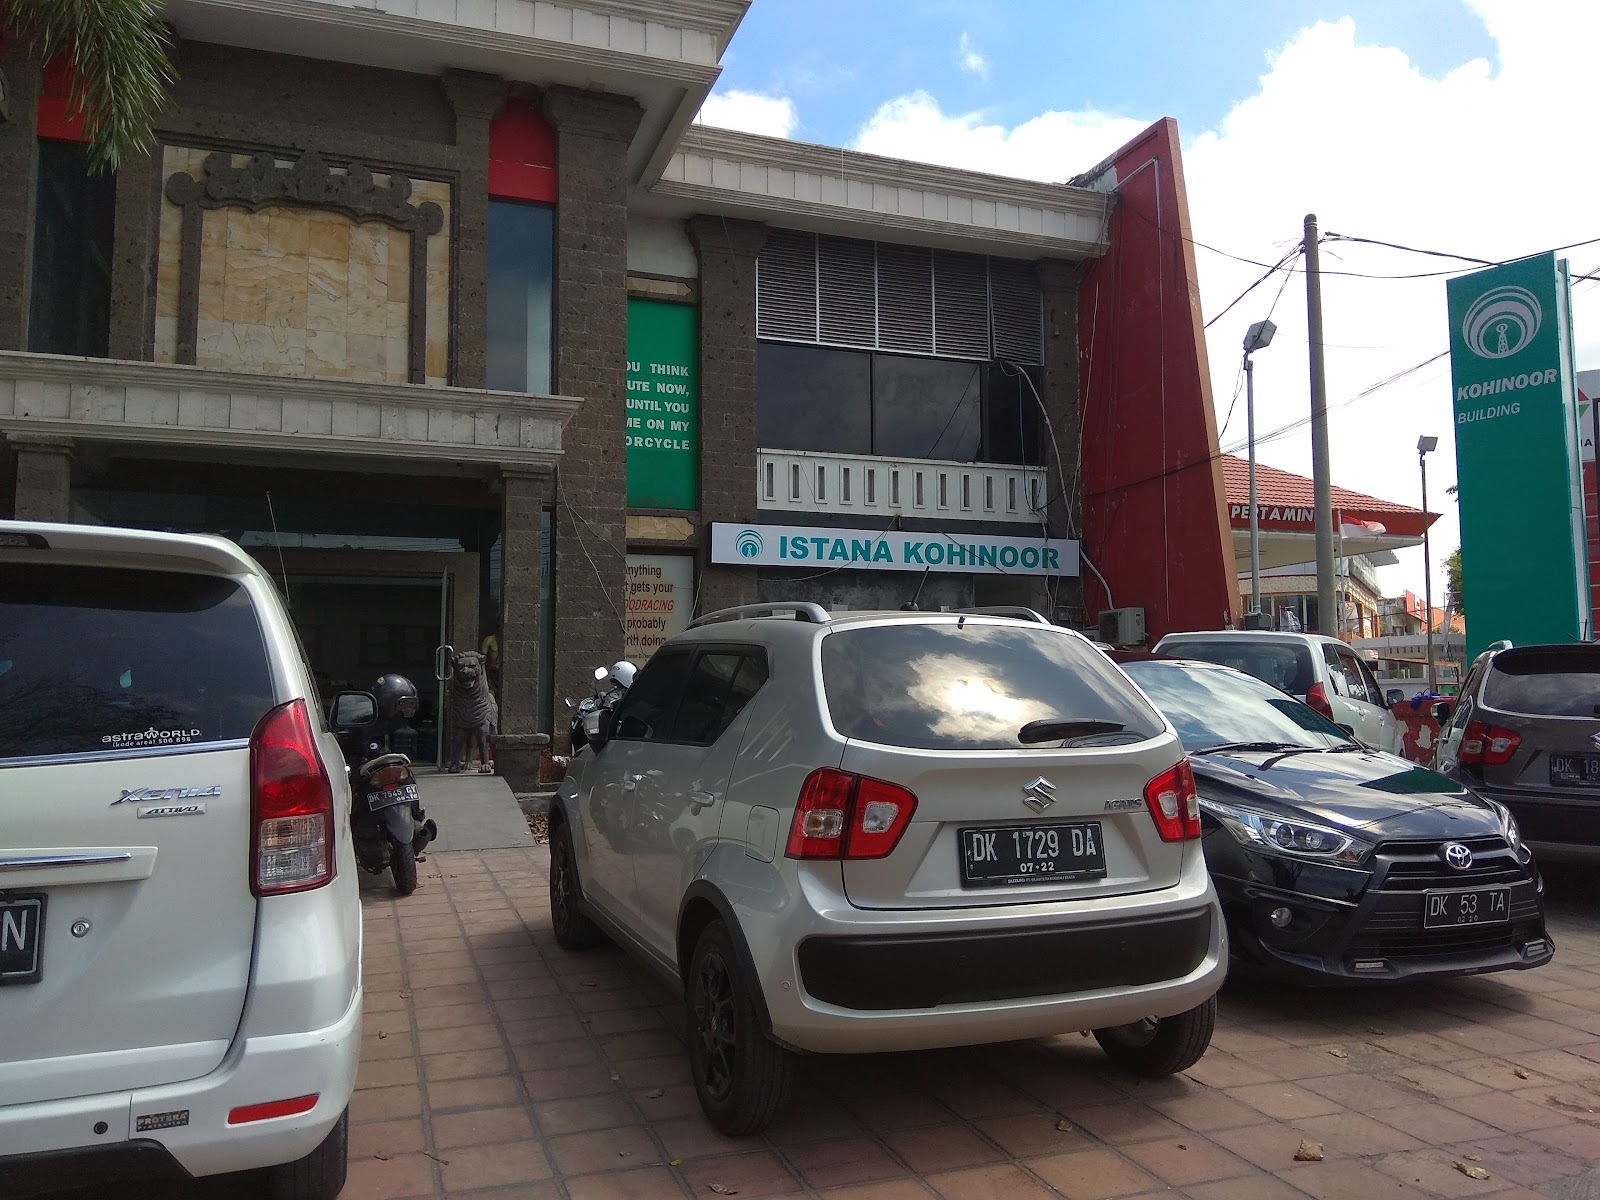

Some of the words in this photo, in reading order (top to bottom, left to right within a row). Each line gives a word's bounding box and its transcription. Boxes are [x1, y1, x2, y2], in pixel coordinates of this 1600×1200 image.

[650, 363, 689, 376] THINK
[627, 380, 650, 392] UTE
[656, 382, 689, 397] NOW,
[1456, 368, 1558, 401] KOHINOOR
[626, 399, 662, 412] UNTIL
[664, 402, 690, 414] YOU
[1457, 402, 1521, 424] BUILDING
[646, 419, 665, 430] ON
[670, 421, 690, 432] MY
[780, 535, 893, 563] ISTANA
[904, 541, 1060, 569] KOHINOOR
[631, 581, 650, 595] gets
[652, 583, 674, 596] your
[627, 617, 666, 632] probably
[1556, 758, 1573, 772] DK
[369, 793, 380, 803] DK
[145, 806, 199, 815] ATTIVO
[972, 833, 998, 862] DK
[1012, 831, 1060, 859] 1729
[1071, 828, 1097, 857] DA
[1430, 895, 1448, 916] DK
[1460, 894, 1478, 914] 53
[1489, 892, 1505, 912] TA
